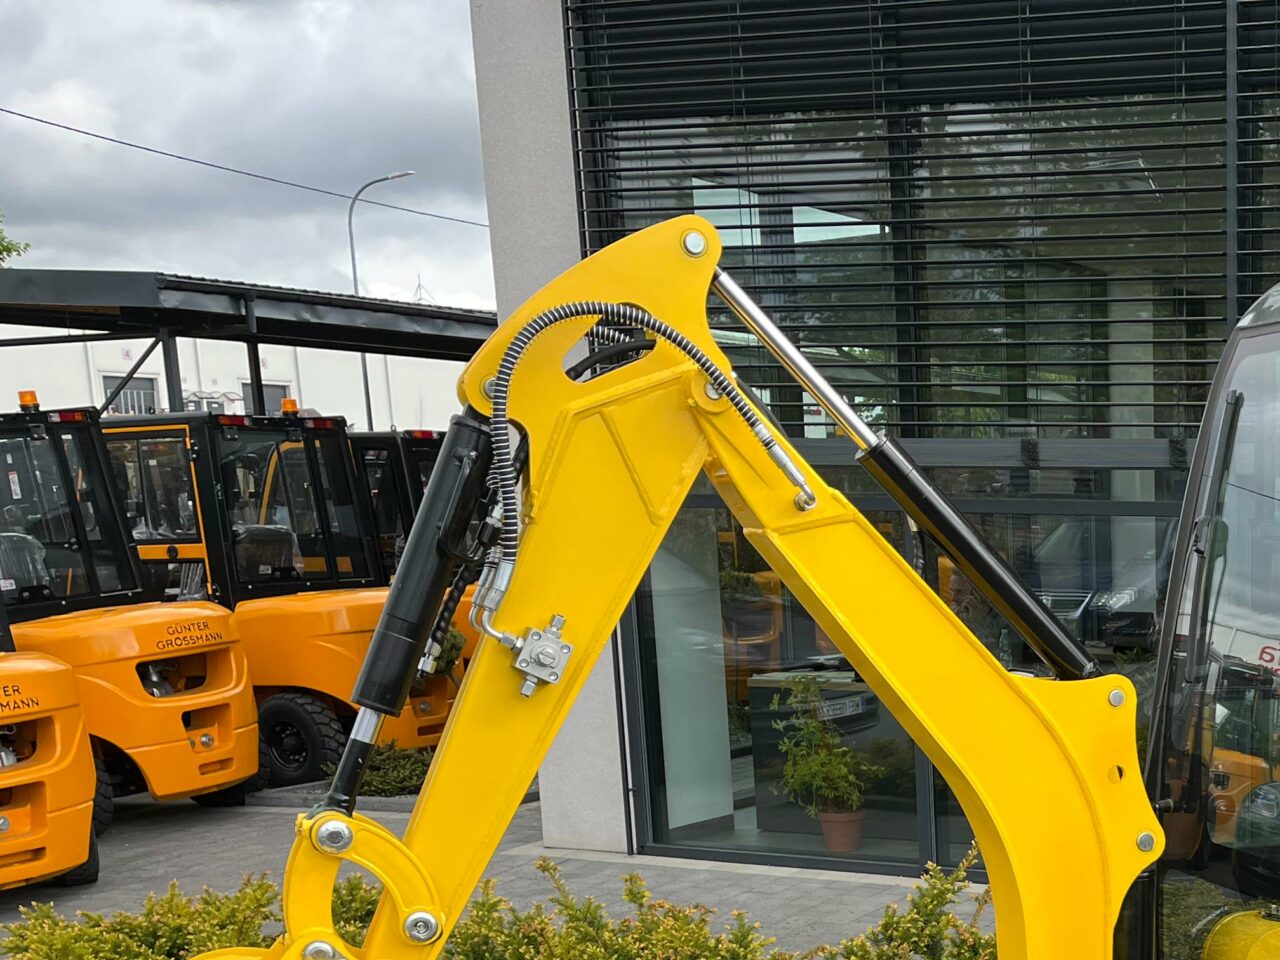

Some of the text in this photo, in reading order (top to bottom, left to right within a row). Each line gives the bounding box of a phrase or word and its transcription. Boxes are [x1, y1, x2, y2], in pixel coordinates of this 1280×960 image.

[166, 621, 210, 635] GÜNTER
[156, 632, 223, 650] GROSSMANN
[0, 685, 21, 697] ER
